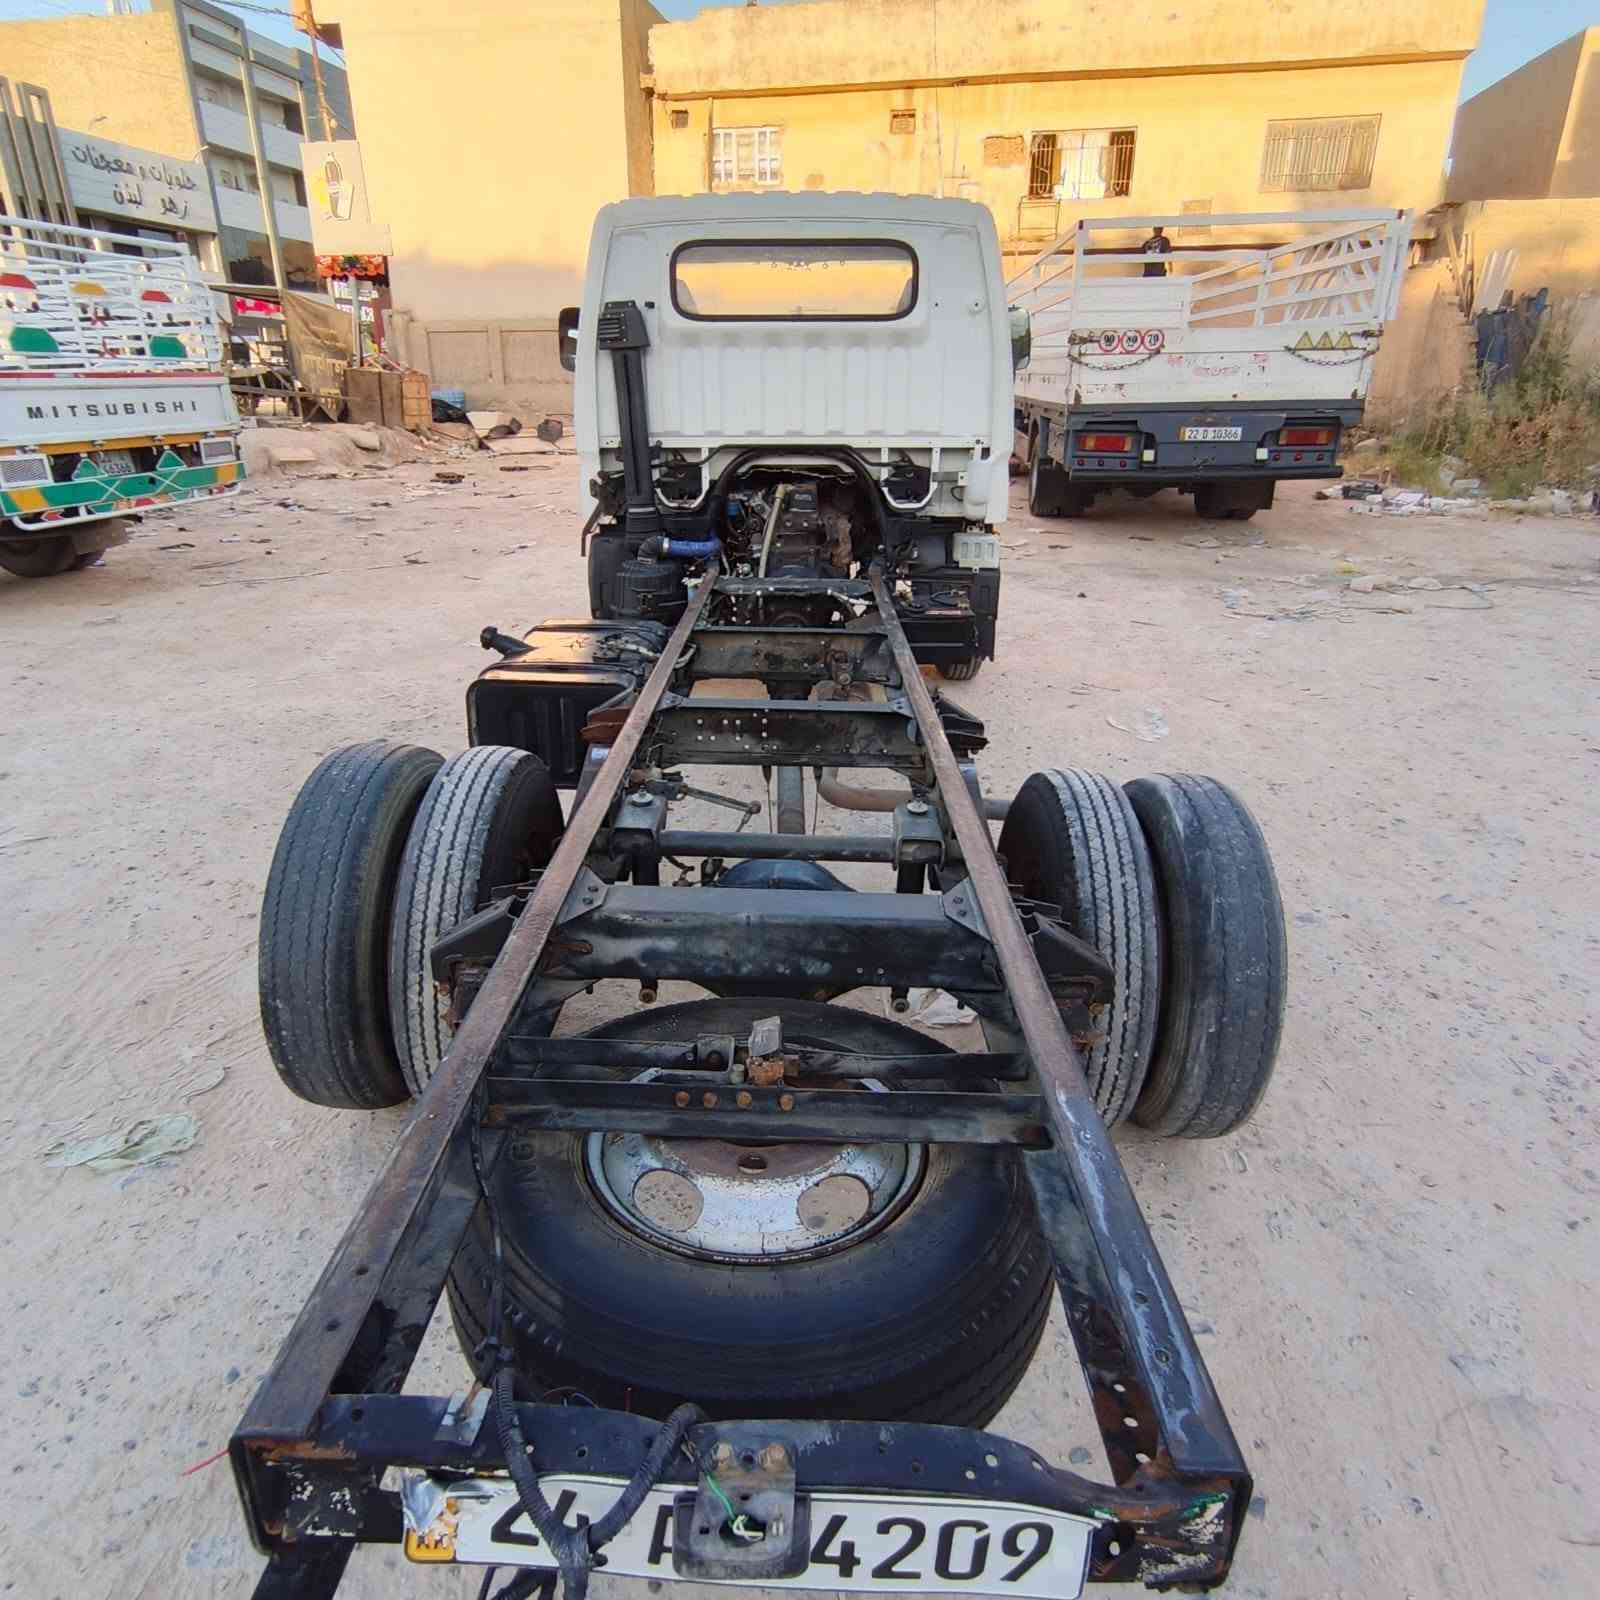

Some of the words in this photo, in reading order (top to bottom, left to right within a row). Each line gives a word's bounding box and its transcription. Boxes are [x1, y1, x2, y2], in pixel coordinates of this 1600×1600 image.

[26, 401, 197, 419] MITSUBISHI
[1187, 428, 1199, 440] 22
[809, 1514, 1054, 1583] 4209
